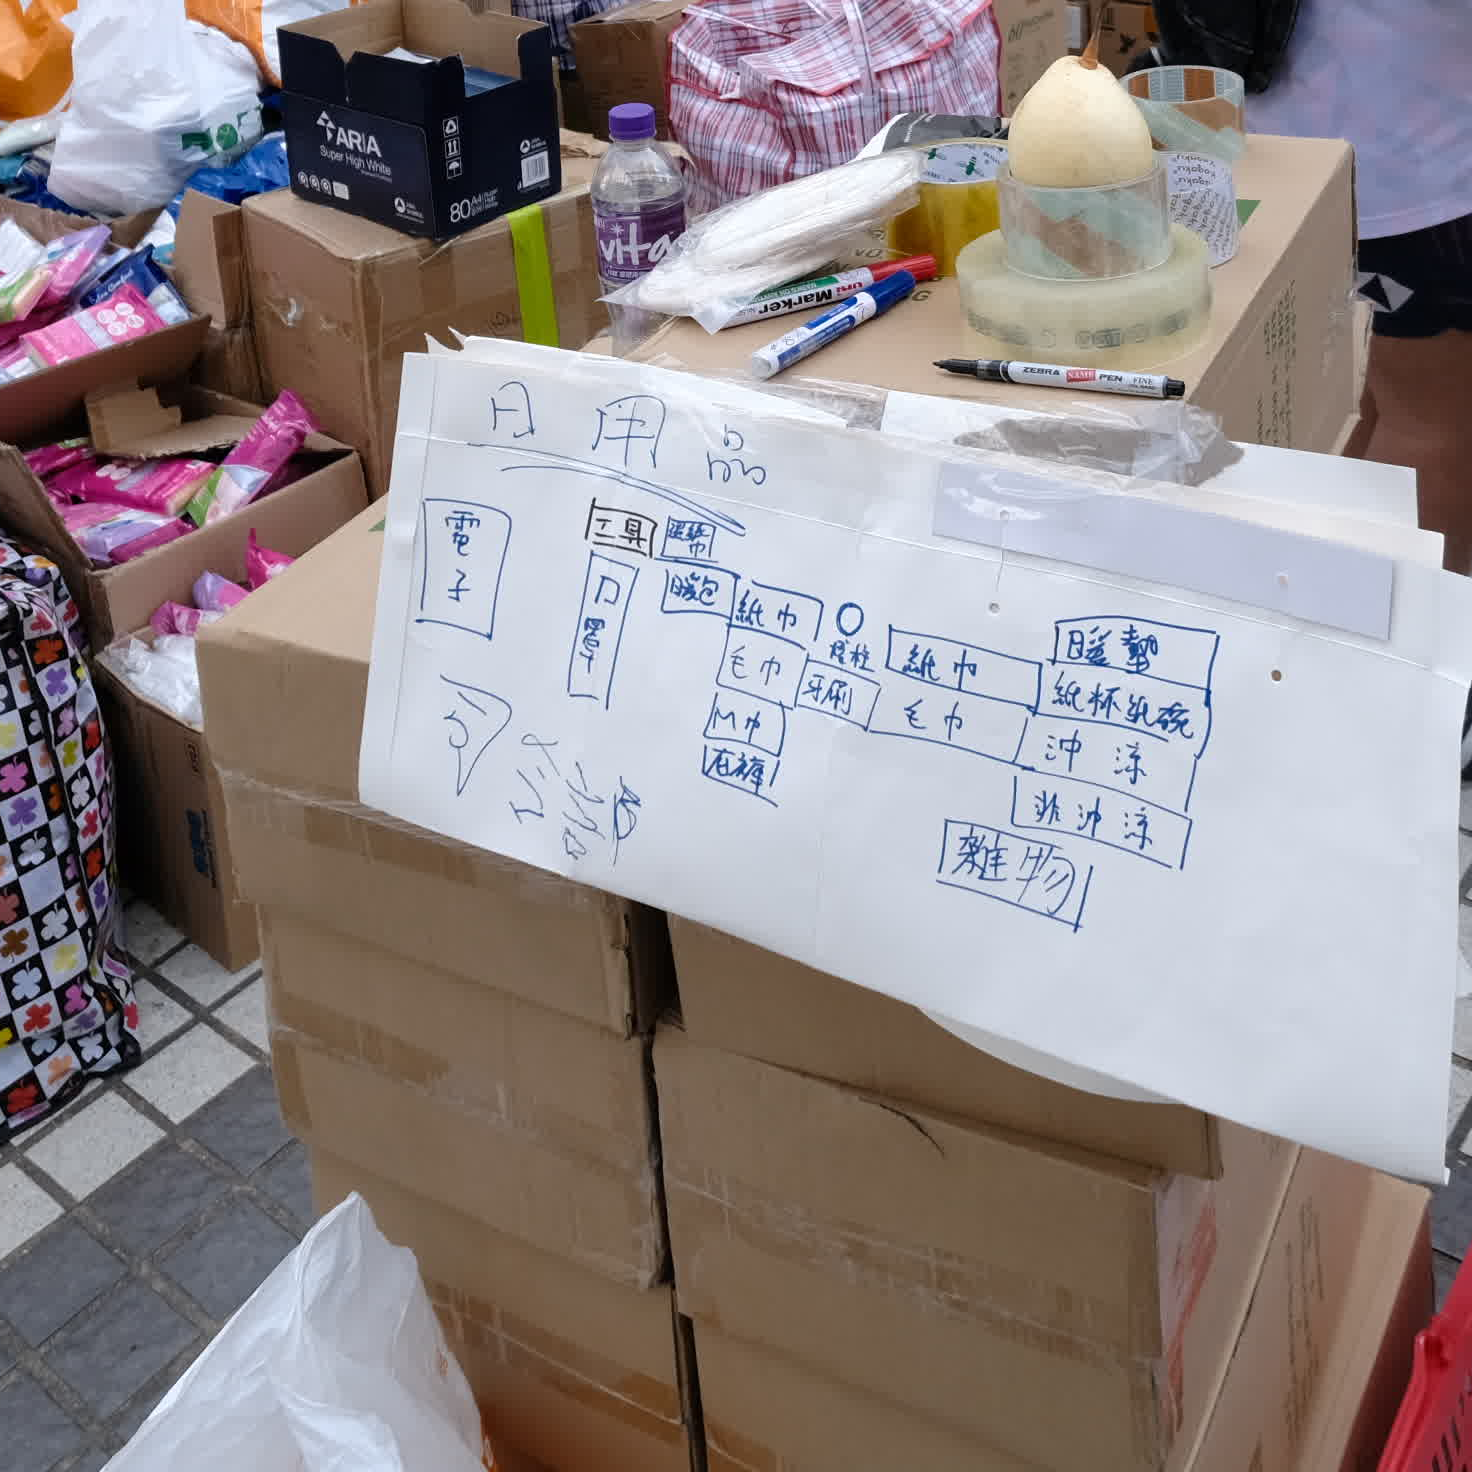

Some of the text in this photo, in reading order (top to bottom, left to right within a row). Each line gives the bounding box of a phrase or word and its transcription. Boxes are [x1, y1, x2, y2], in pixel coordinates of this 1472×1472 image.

[320, 145, 344, 163] Super
[345, 153, 365, 170] High
[366, 159, 392, 176] White
[336, 127, 382, 158] ARIA
[450, 199, 471, 222] 80
[758, 289, 833, 315] Marker
[1024, 366, 1060, 377] ZEBRA
[1099, 374, 1123, 383] PEN
[1133, 377, 1154, 385] FINE
[490, 381, 766, 484] 日用品
[594, 518, 647, 548] 工具
[445, 511, 480, 602] 電子
[670, 572, 719, 606] 暖包
[580, 574, 620, 674] 口罩
[736, 589, 797, 633] 紙巾
[730, 645, 781, 686] 毛巾
[902, 644, 978, 690] 紙巾
[802, 674, 853, 715] 牙刷
[903, 699, 963, 741] 毛巾
[952, 825, 1076, 915] 雜物
